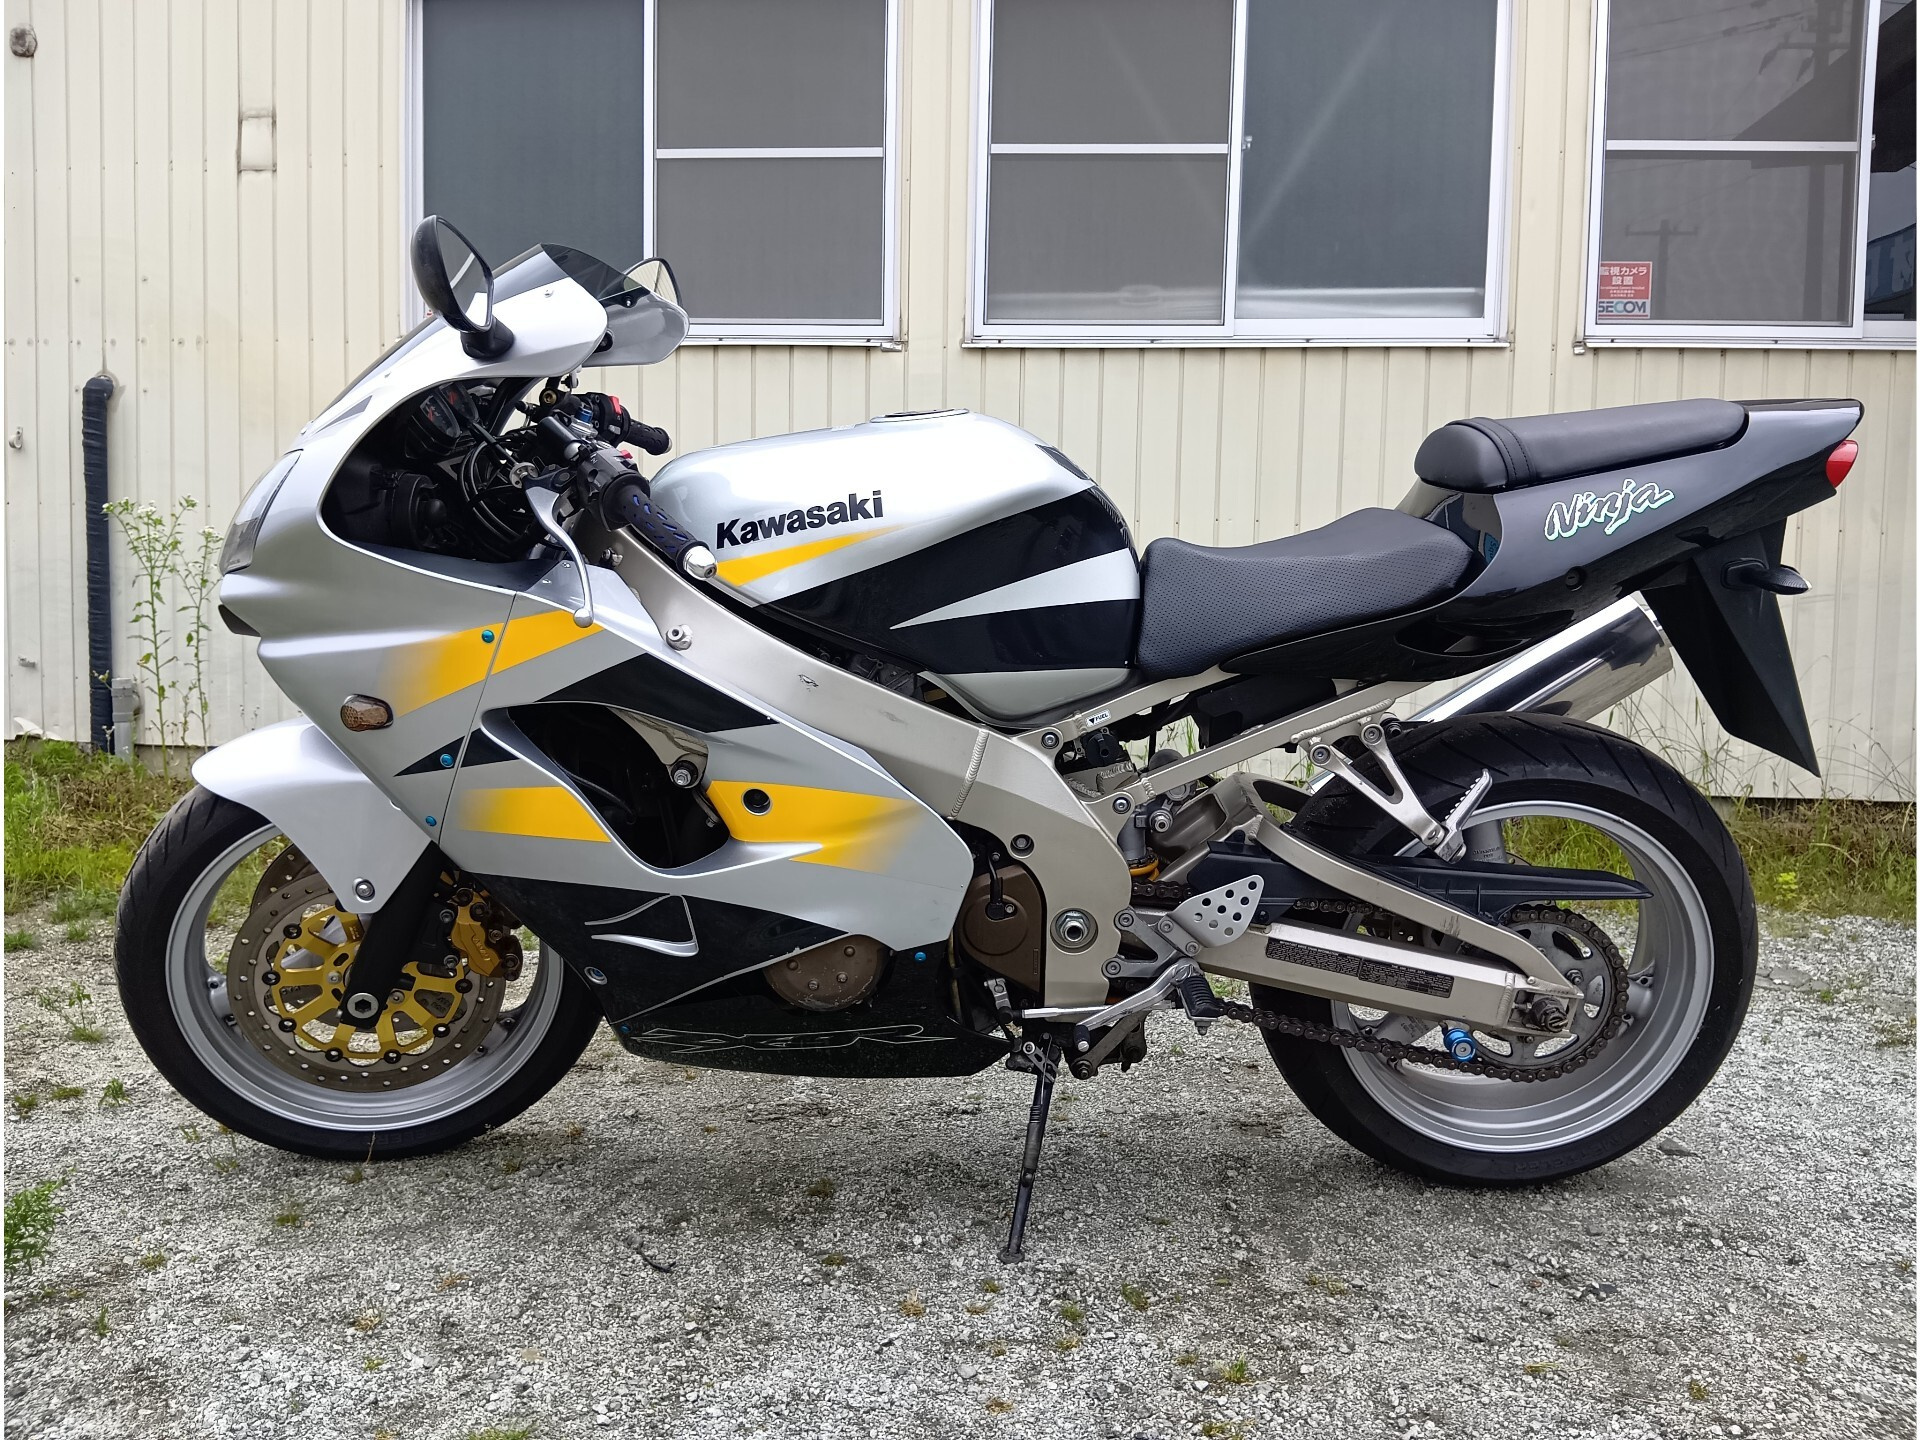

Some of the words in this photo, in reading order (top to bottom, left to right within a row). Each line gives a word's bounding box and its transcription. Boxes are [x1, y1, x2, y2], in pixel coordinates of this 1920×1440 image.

[1598, 301, 1646, 313] SECOM
[716, 490, 883, 549] Kawasaki
[1544, 479, 1675, 541] Ninja
[1095, 713, 1108, 721] FUEL
